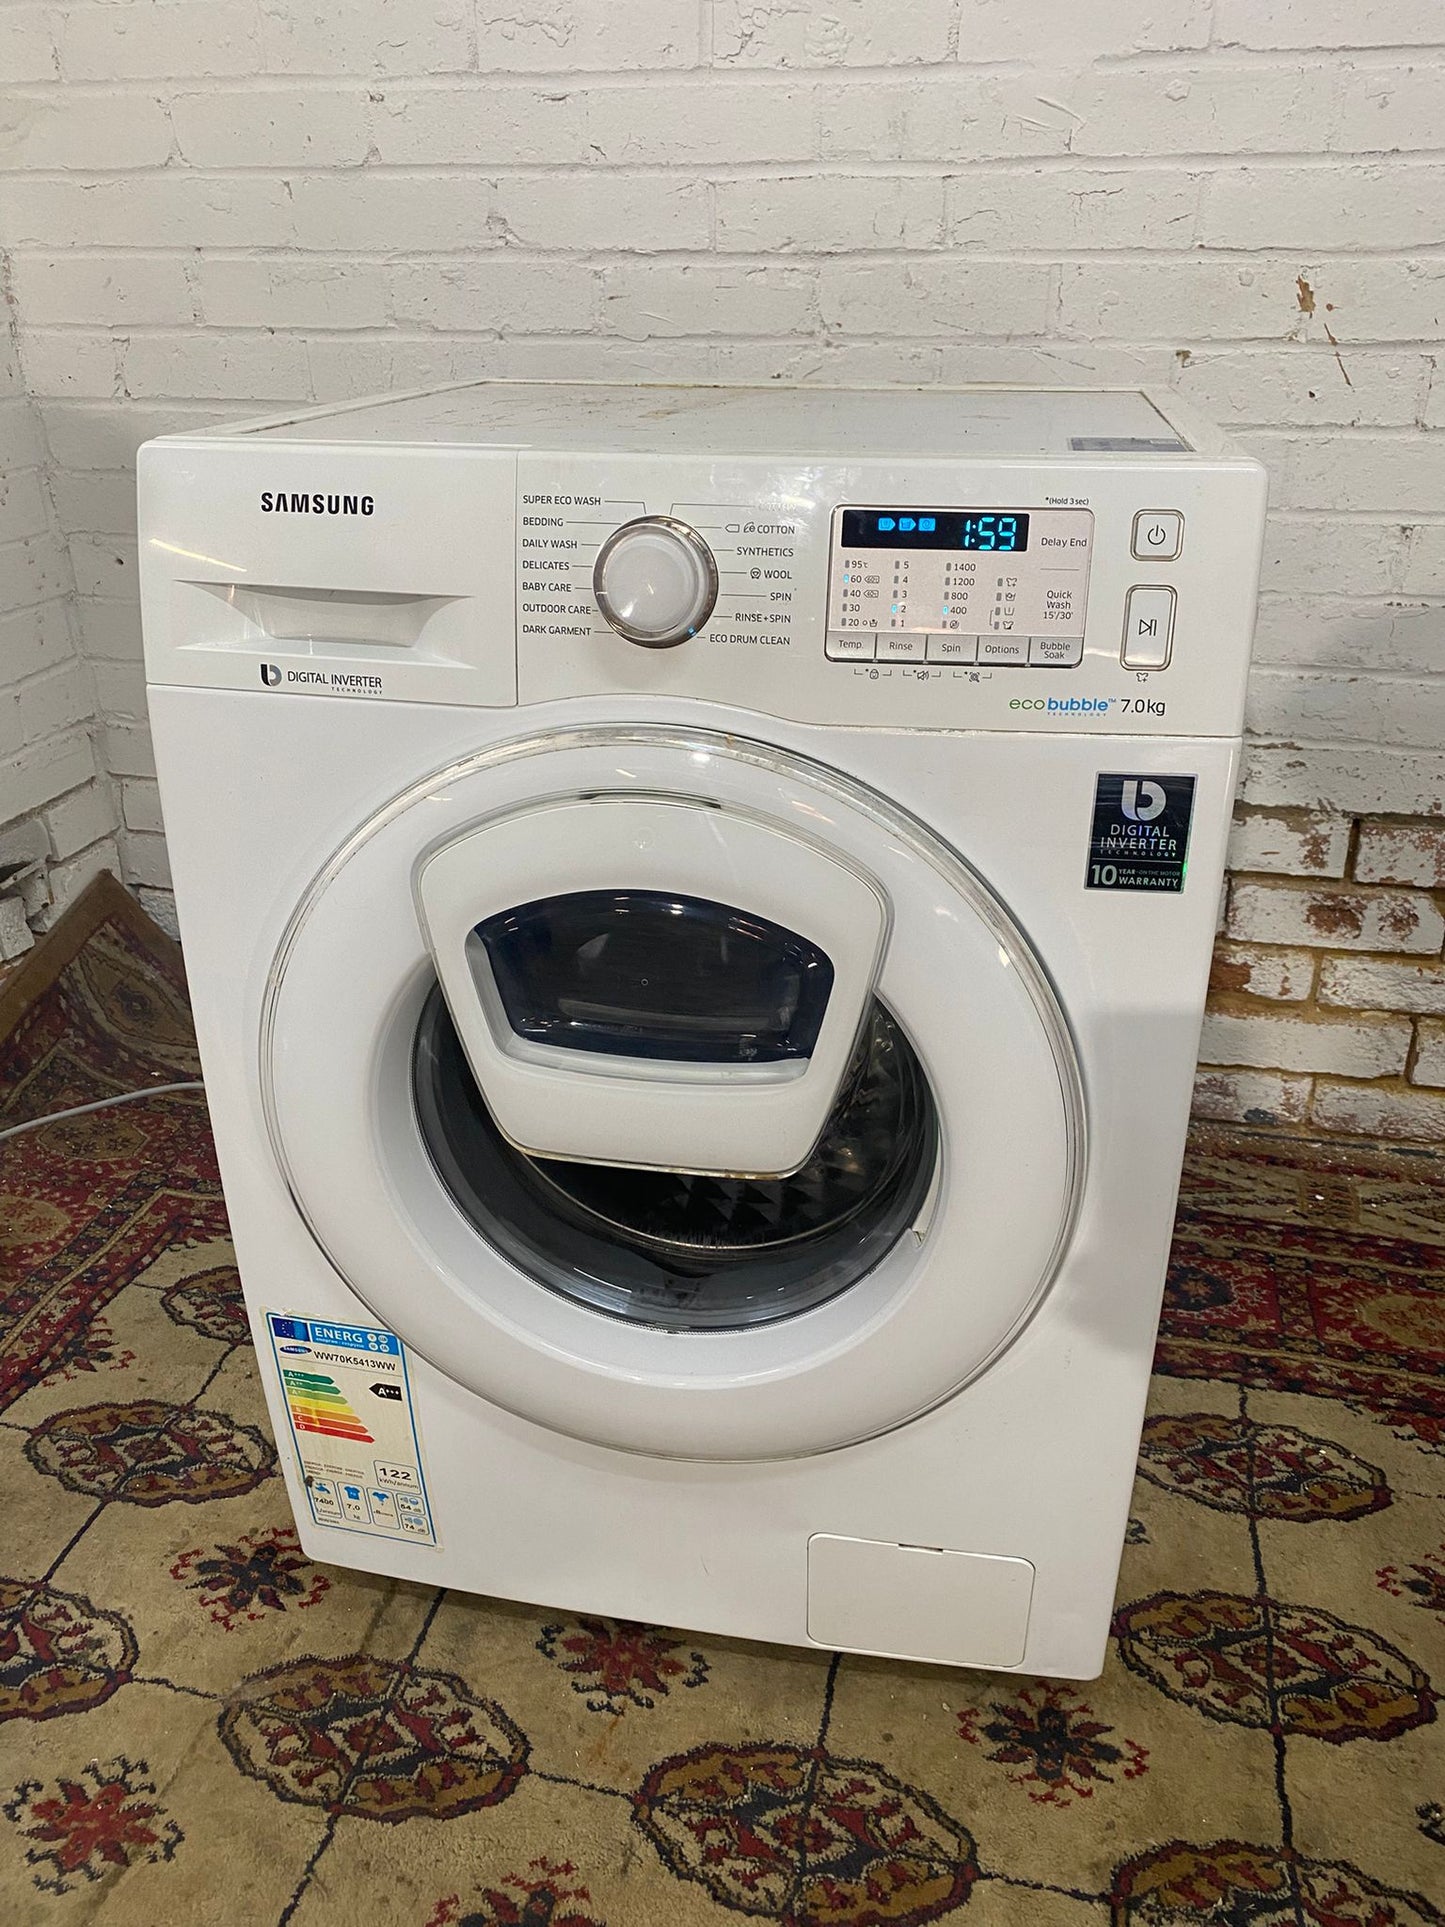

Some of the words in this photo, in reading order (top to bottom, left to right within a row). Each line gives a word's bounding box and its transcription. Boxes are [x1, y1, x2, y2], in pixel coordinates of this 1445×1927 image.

[261, 492, 374, 515] SAMSUNG
[522, 495, 552, 504] SUPER
[554, 496, 572, 505] ECO
[574, 496, 601, 505] WASH
[522, 517, 564, 526] BEDDING
[757, 525, 795, 535] COTTON
[964, 517, 1017, 551] 1:59
[522, 539, 548, 548] DAILY
[551, 540, 577, 549] WASH
[1041, 537, 1067, 548] Delay
[1070, 538, 1087, 547] End
[736, 547, 794, 557] SYNTHETICS
[522, 560, 569, 570] DELICATES
[903, 561, 909, 569] 5
[954, 563, 976, 571] 1400
[763, 570, 792, 579] WOOL
[850, 575, 862, 583] 60
[522, 582, 546, 591] BABY
[548, 583, 572, 592] CARE
[953, 578, 975, 586] 1200
[770, 592, 791, 601] SPIN
[902, 590, 907, 598] 3
[951, 592, 968, 600] 800
[1046, 590, 1072, 599] Quick
[522, 603, 566, 613] OUTDOOR
[568, 605, 591, 614] CARE
[849, 604, 860, 612] 30
[901, 605, 906, 613] 2
[1046, 601, 1071, 609] Wash
[522, 625, 546, 633] DARK
[548, 626, 591, 636] GARMENT
[709, 634, 727, 643] ECO
[730, 635, 757, 644] DRUM
[760, 636, 790, 645] CLEAN
[889, 641, 913, 651] Rinse
[941, 643, 961, 653] Spin
[985, 644, 1019, 655] Options
[1040, 641, 1070, 651] Bubble
[1044, 650, 1065, 660] Soak
[287, 671, 328, 684] DIGITAL
[331, 674, 382, 688] INVERTER
[1110, 824, 1170, 837] DIGITAL
[1100, 837, 1177, 850] INVERTER
[1092, 864, 1117, 885] 10
[1119, 877, 1179, 888] WARRANTY
[314, 1327, 363, 1343] ENERG
[313, 1350, 396, 1371] WW70K5413WW
[380, 1467, 411, 1480] 122
